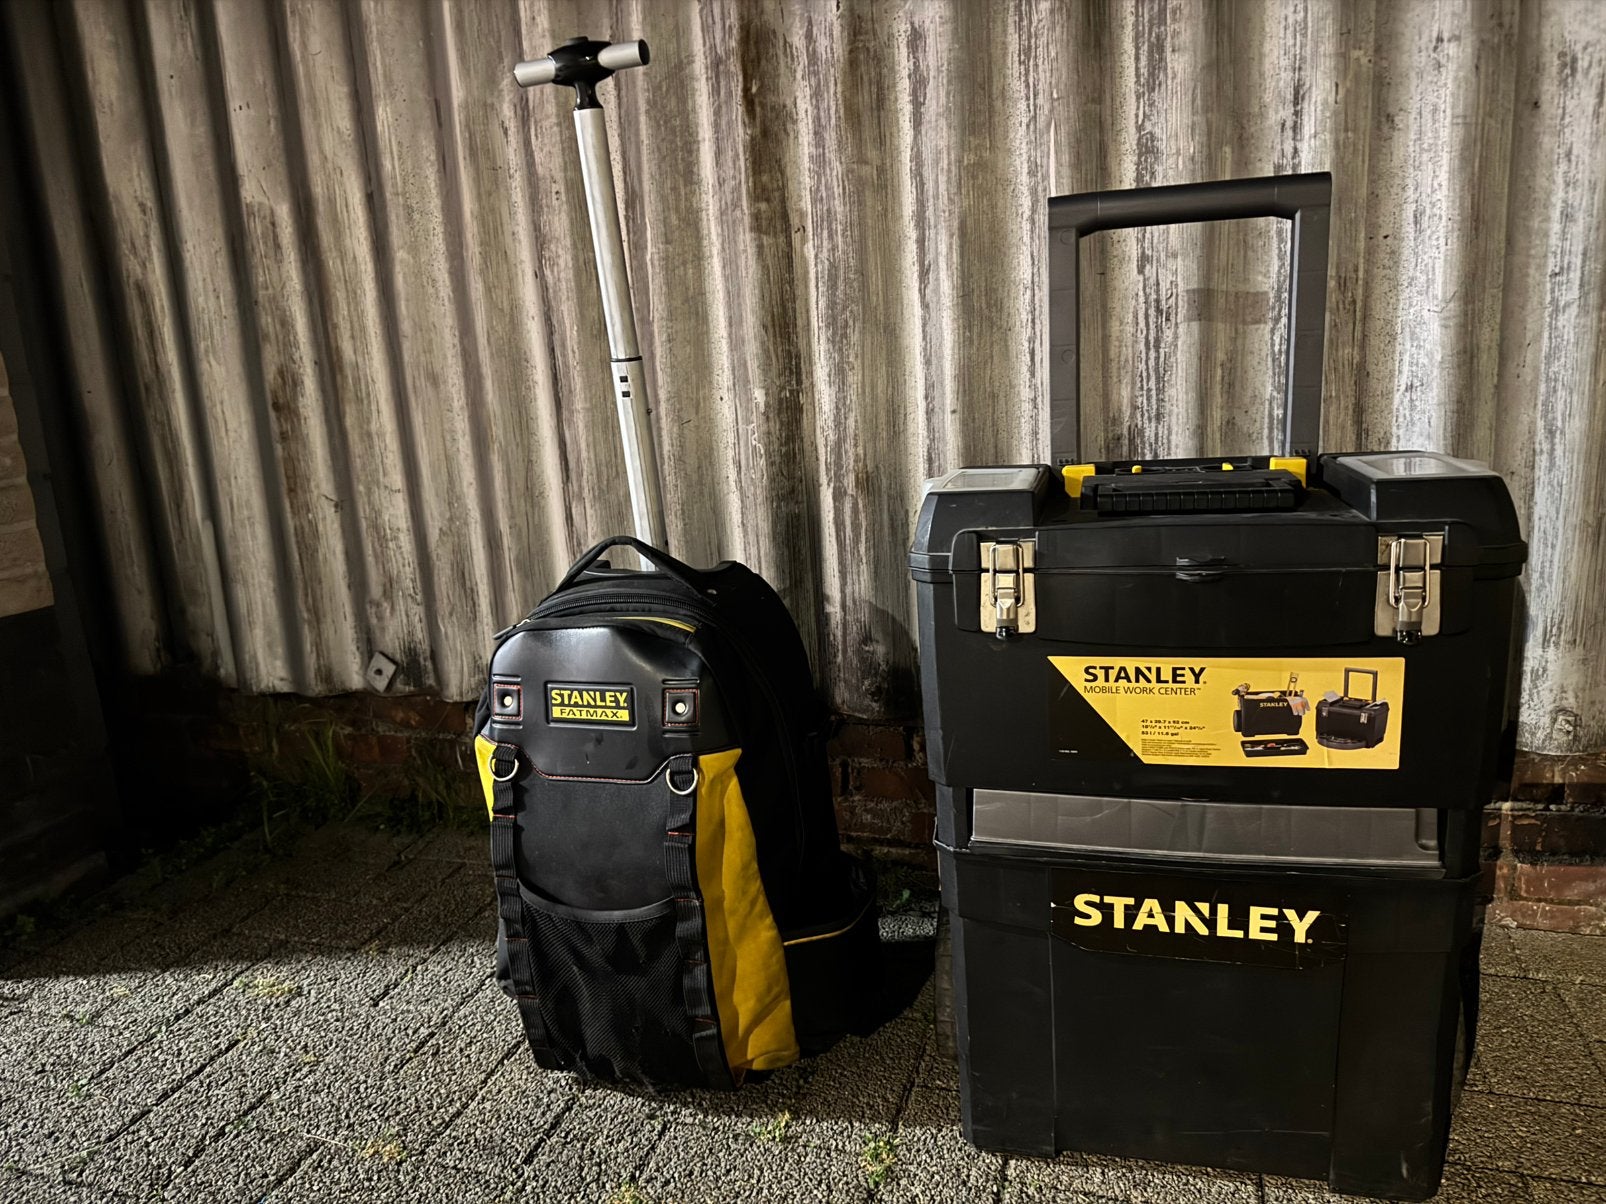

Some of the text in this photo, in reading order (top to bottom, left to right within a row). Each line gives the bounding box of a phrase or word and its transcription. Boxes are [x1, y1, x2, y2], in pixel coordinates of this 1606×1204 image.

[1083, 665, 1207, 684] STANLEY
[1083, 685, 1121, 694] MOBILE
[1123, 686, 1156, 695] WORK
[1073, 892, 1321, 944] STANLEY
